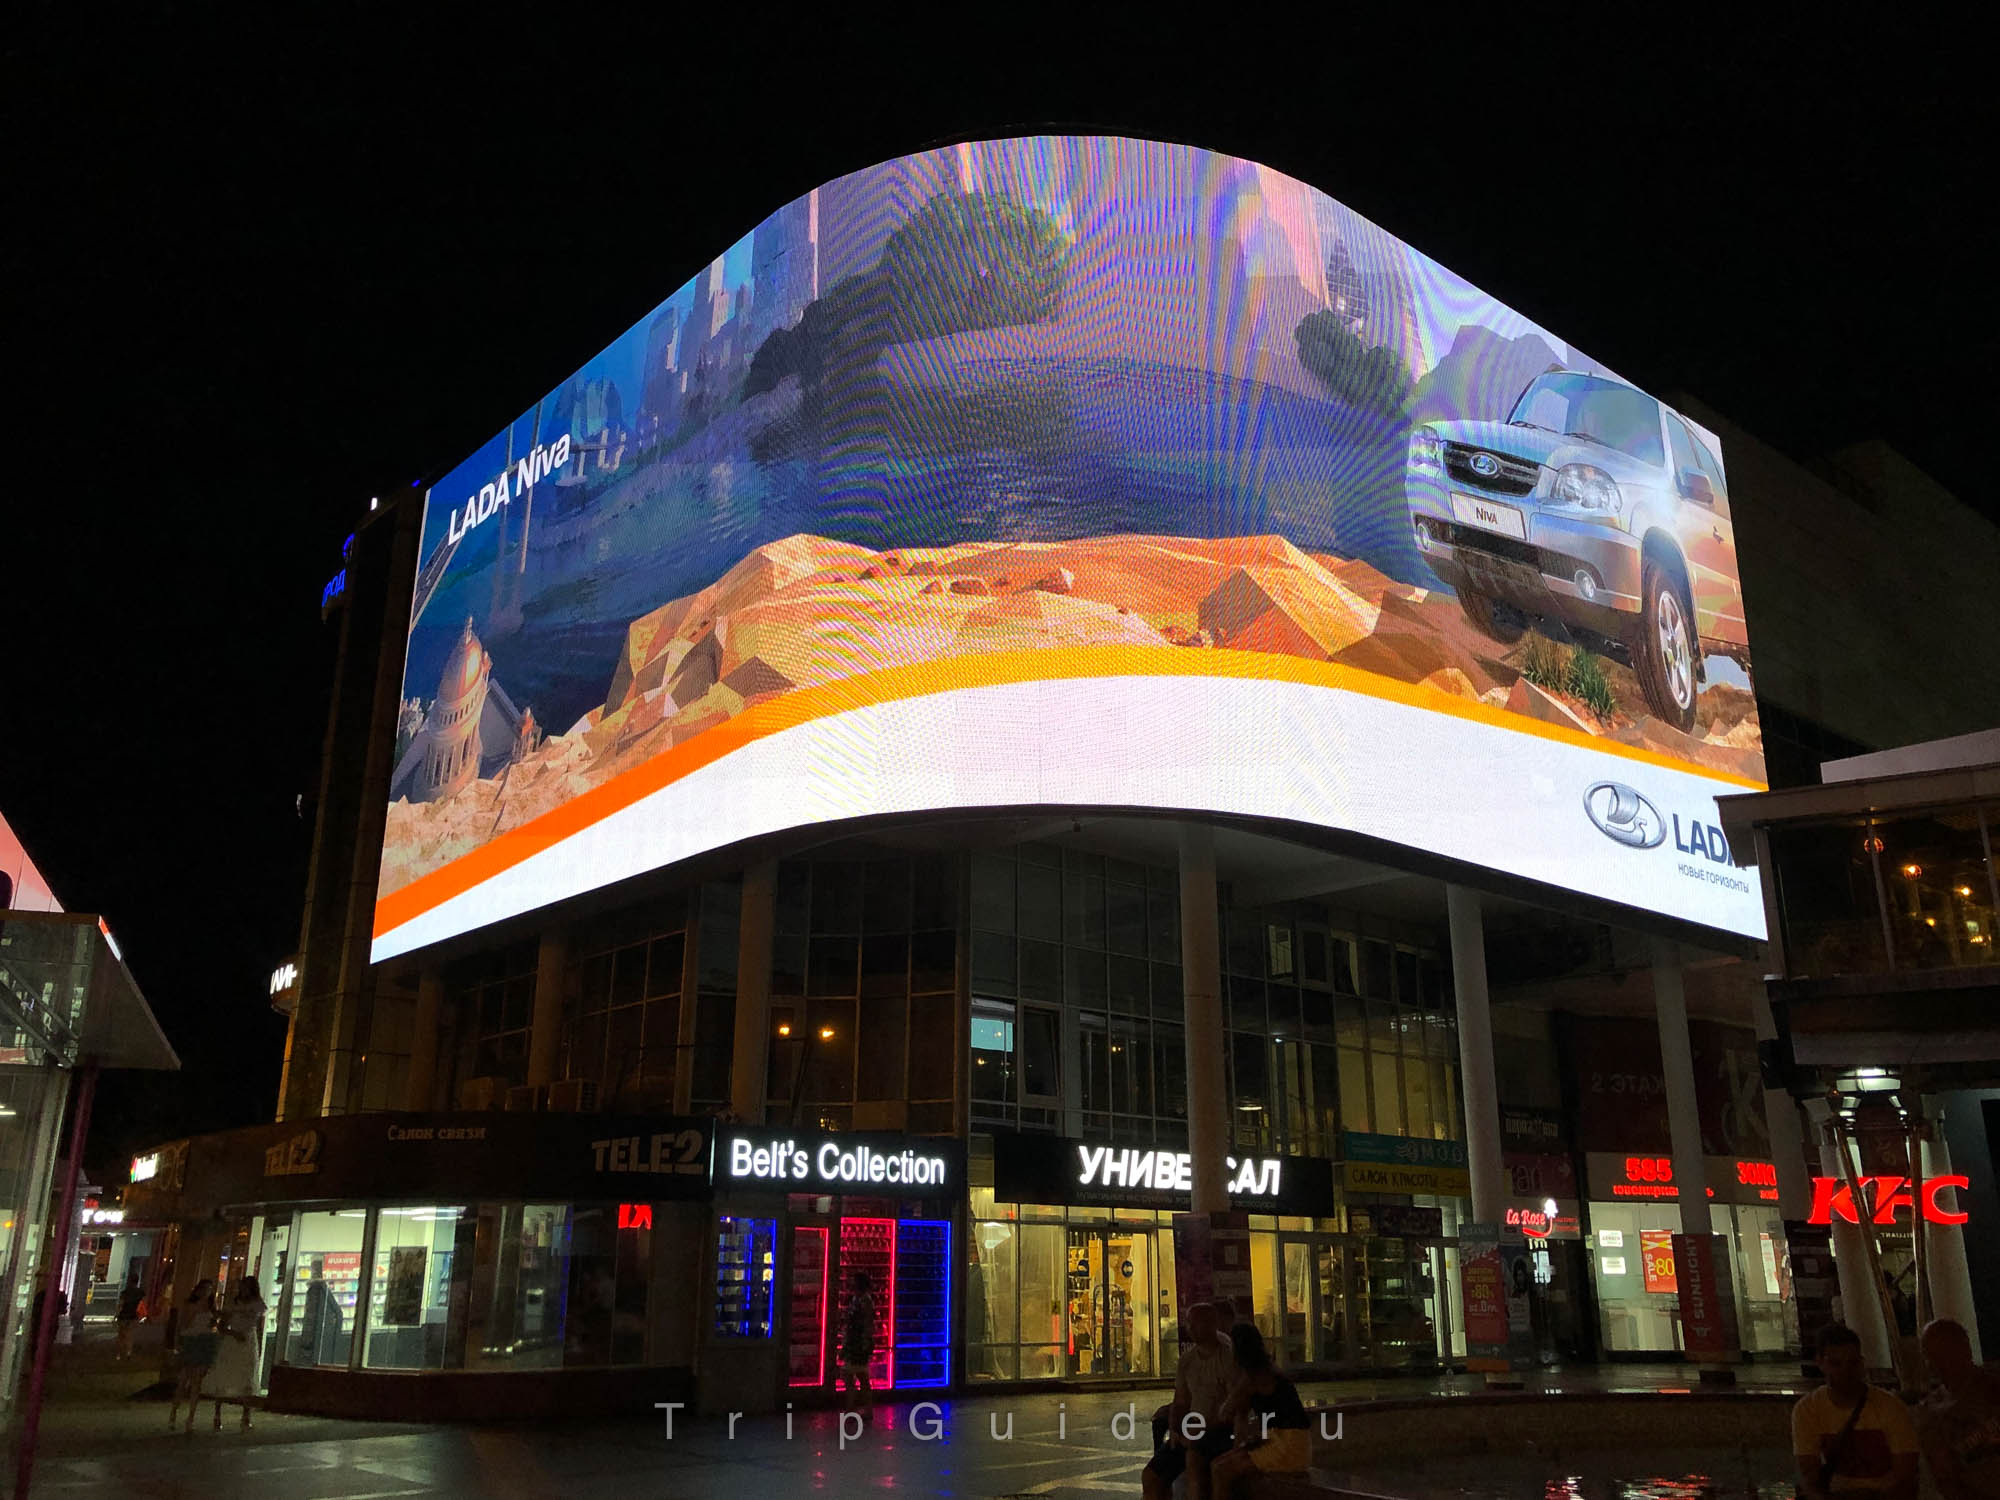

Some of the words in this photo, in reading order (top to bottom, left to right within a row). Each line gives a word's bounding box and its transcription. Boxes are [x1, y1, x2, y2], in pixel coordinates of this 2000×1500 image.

[448, 471, 510, 545] LADA
[516, 433, 570, 496] Niva
[1672, 813, 1746, 871] LAD
[1678, 864, 1705, 881] НОВЫЕ
[1706, 871, 1749, 893] ГОРИЗОНТЫ
[264, 1129, 321, 1176] TELE2
[387, 1123, 433, 1141] Салон
[438, 1127, 488, 1140] связи
[591, 1128, 704, 1176] TELE2
[731, 1138, 808, 1179] Belt's
[817, 1142, 945, 1184] Collection
[1078, 1145, 1281, 1196] УНИВЕАЛ
[1626, 1157, 1673, 1182] 585
[1521, 1208, 1547, 1226] Rose
[1807, 1174, 1969, 1225] KFC
[1645, 1253, 1658, 1282] SALE
[1686, 1236, 1705, 1319] SUNLIGHT
